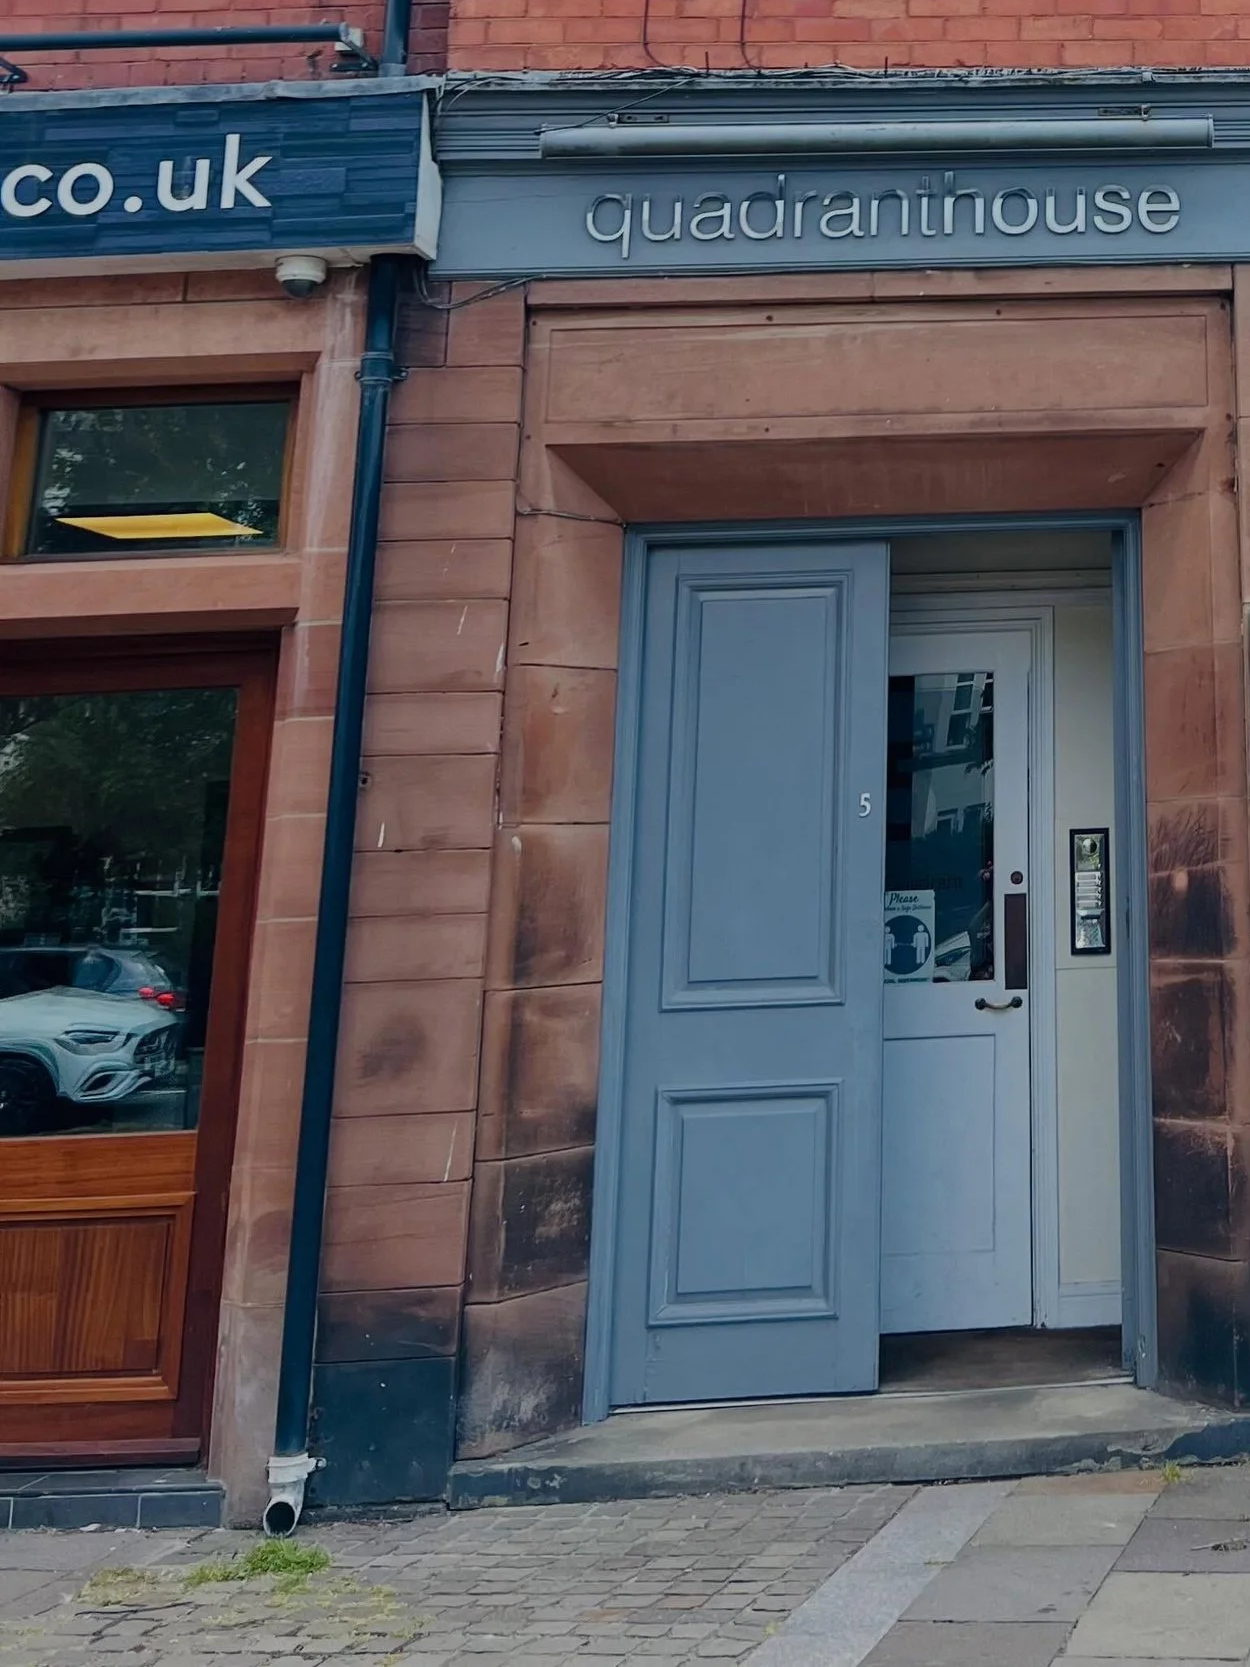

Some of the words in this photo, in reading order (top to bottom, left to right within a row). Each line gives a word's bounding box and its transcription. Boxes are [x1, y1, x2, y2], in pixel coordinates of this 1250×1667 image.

[1, 133, 273, 218] co.uk
[586, 172, 1182, 259] quadranthouse
[859, 792, 872, 818] 5
[889, 893, 919, 905] Please
